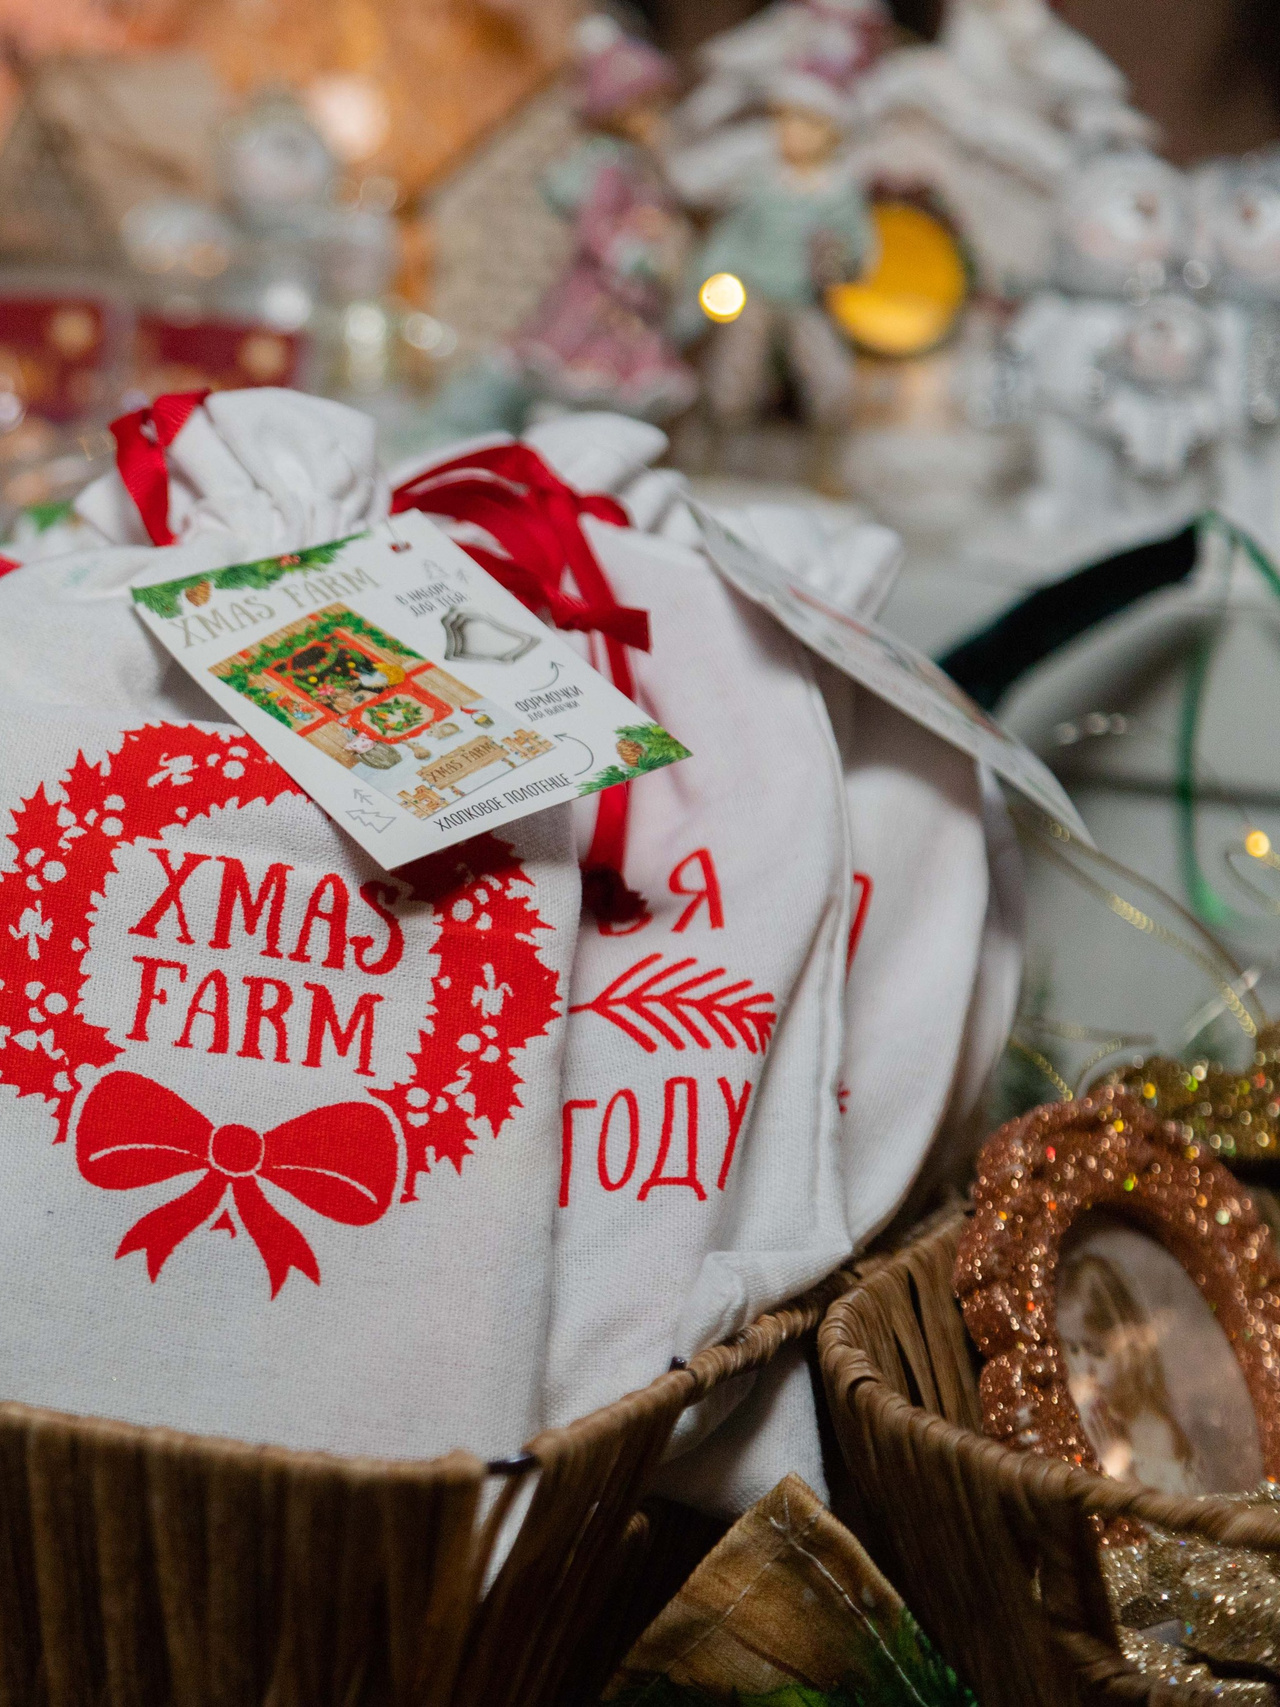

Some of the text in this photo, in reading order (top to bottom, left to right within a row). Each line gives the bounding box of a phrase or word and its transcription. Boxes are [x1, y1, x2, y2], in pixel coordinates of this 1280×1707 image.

[170, 566, 380, 648] XMAS FARM
[514, 684, 584, 712] ФОРМОЧКИ
[526, 710, 546, 722] ДЛЯ
[426, 740, 497, 784] XMAS FARM
[433, 773, 574, 832] ХЛОПКОВОЕ ПОЛОТЕНЦЕ
[127, 848, 405, 975] XMAS
[125, 955, 385, 1078] FARM
[558, 1076, 754, 1208] ГОДУ
